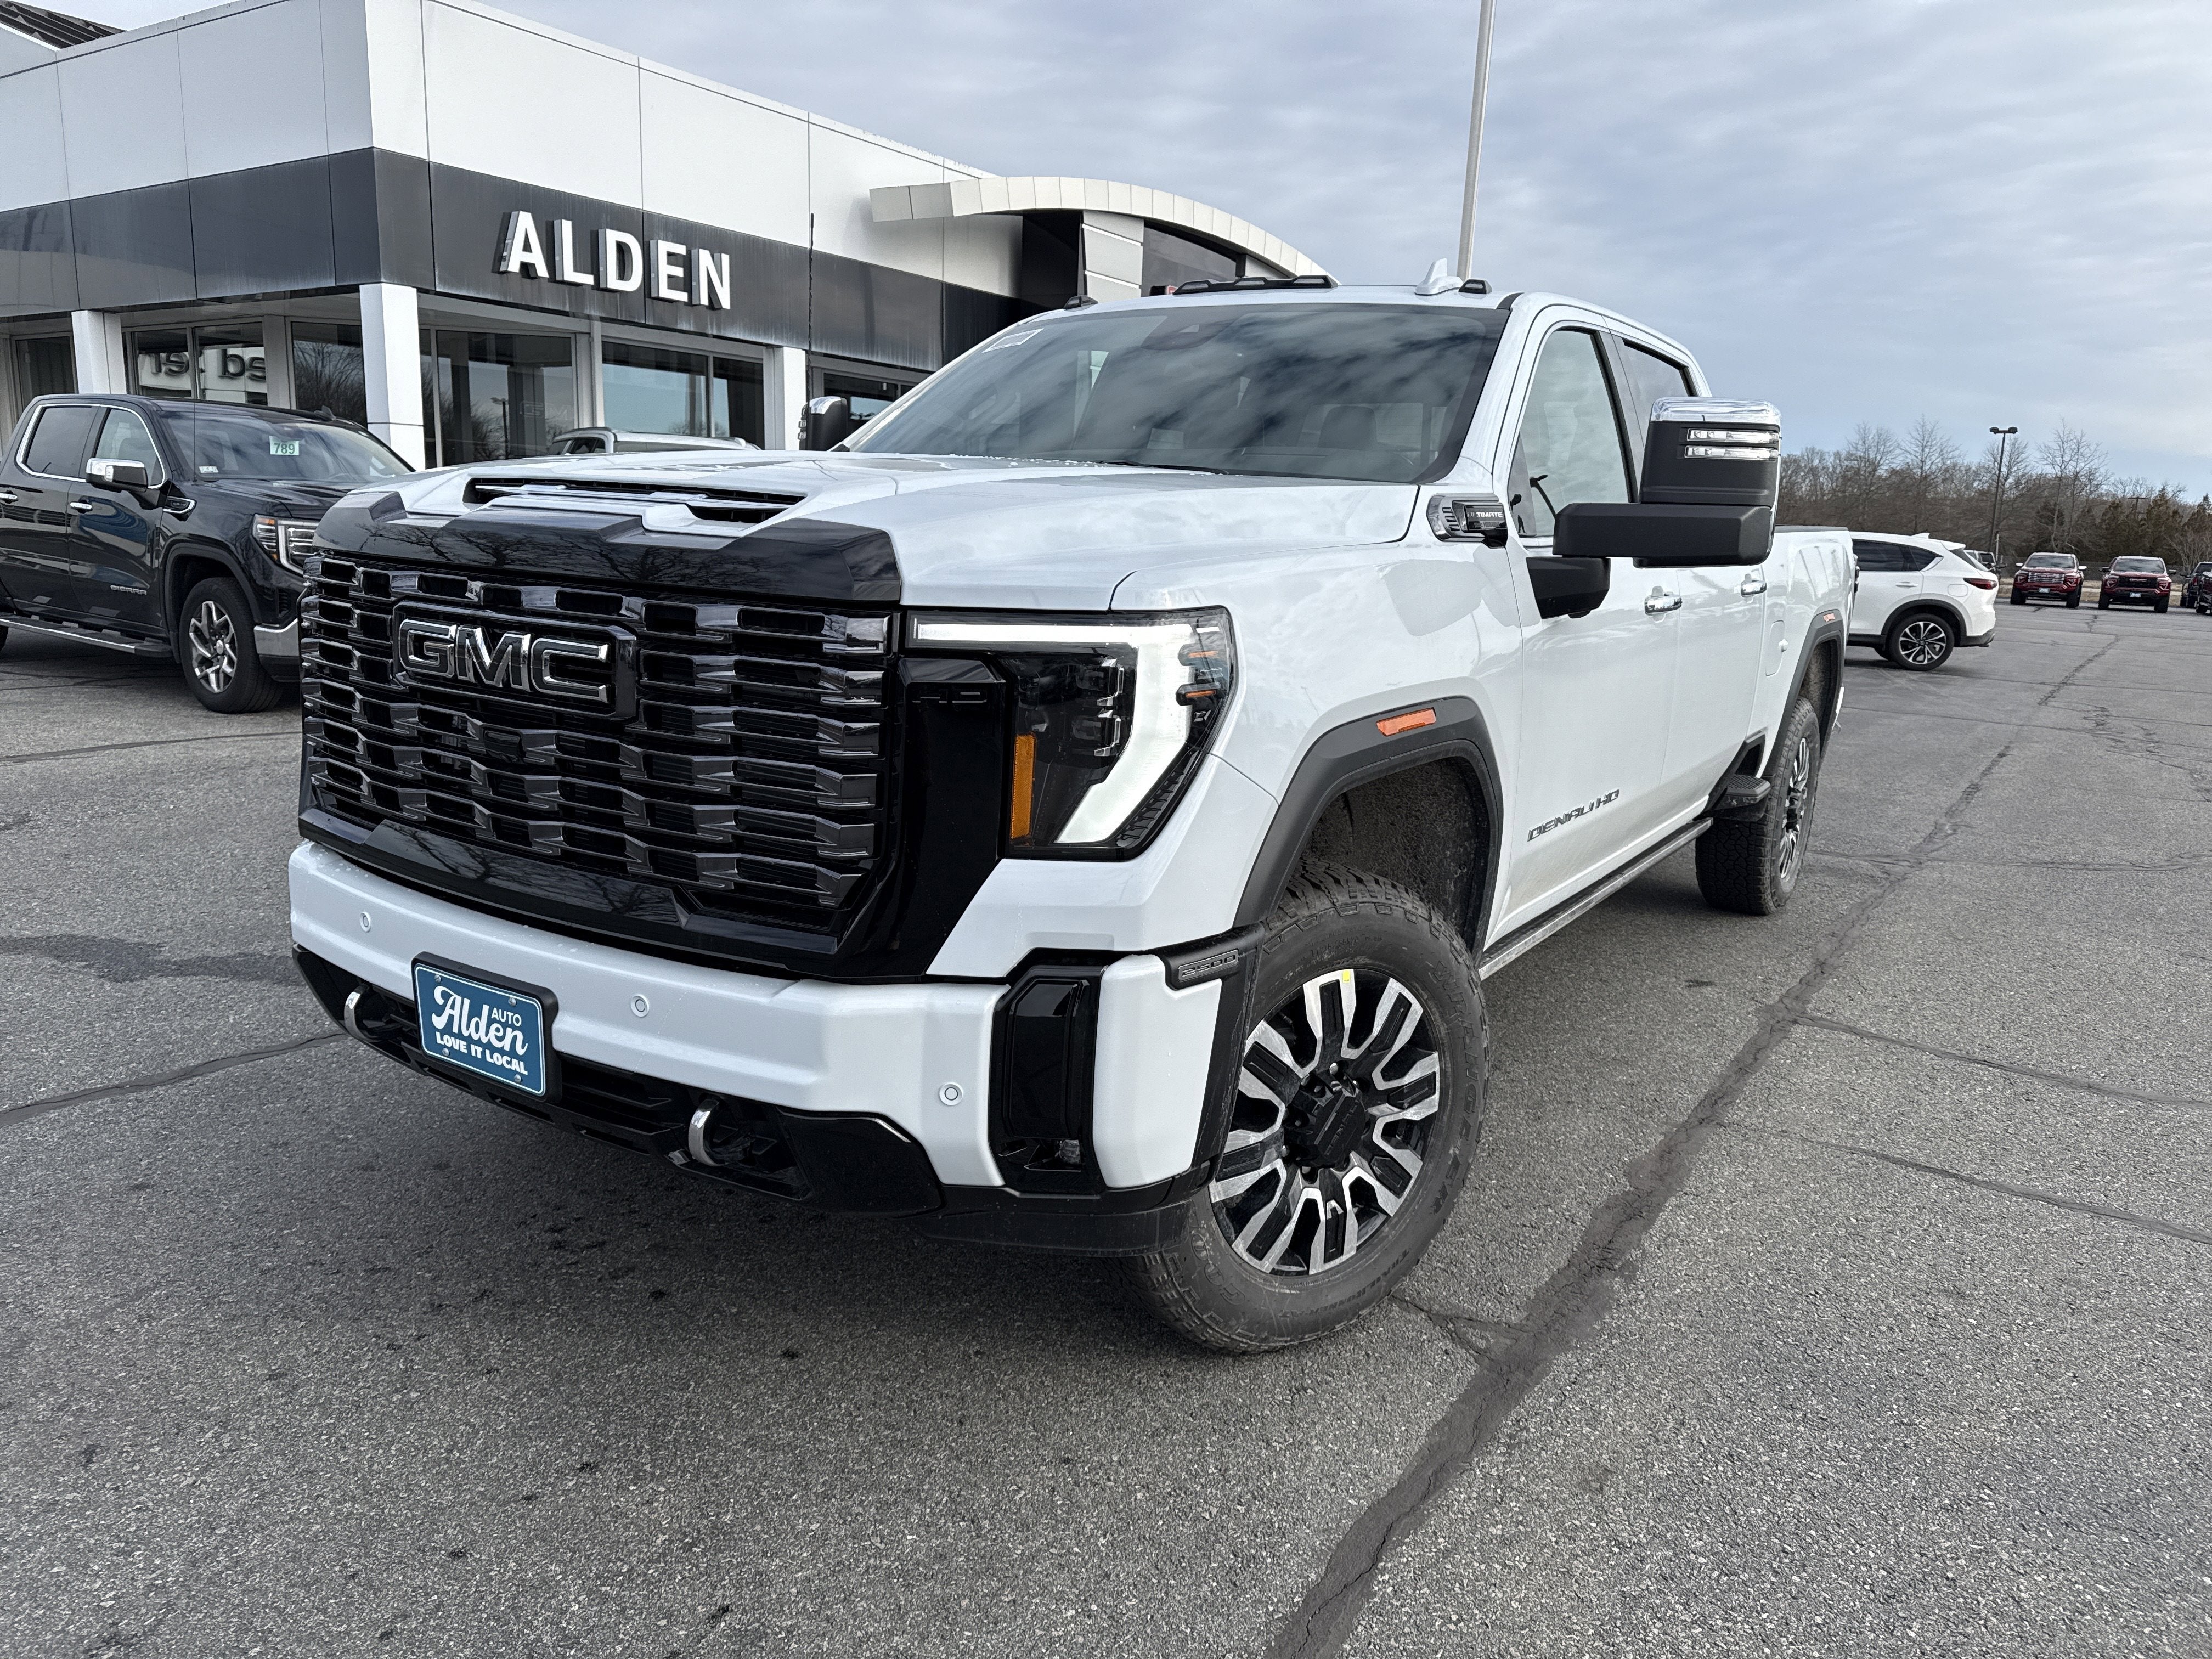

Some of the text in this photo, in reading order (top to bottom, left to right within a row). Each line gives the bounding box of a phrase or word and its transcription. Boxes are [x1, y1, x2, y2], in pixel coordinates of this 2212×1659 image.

[499, 210, 731, 310] ALDEN
[274, 442, 296, 455] 789
[399, 618, 609, 704] GMC
[1527, 787, 1620, 842] DENALI HD
[1181, 955, 1236, 978] 2500
[431, 985, 528, 1056] Alden
[491, 1007, 522, 1027] AUTO
[435, 1031, 528, 1075] LOVE IT LOCAL
